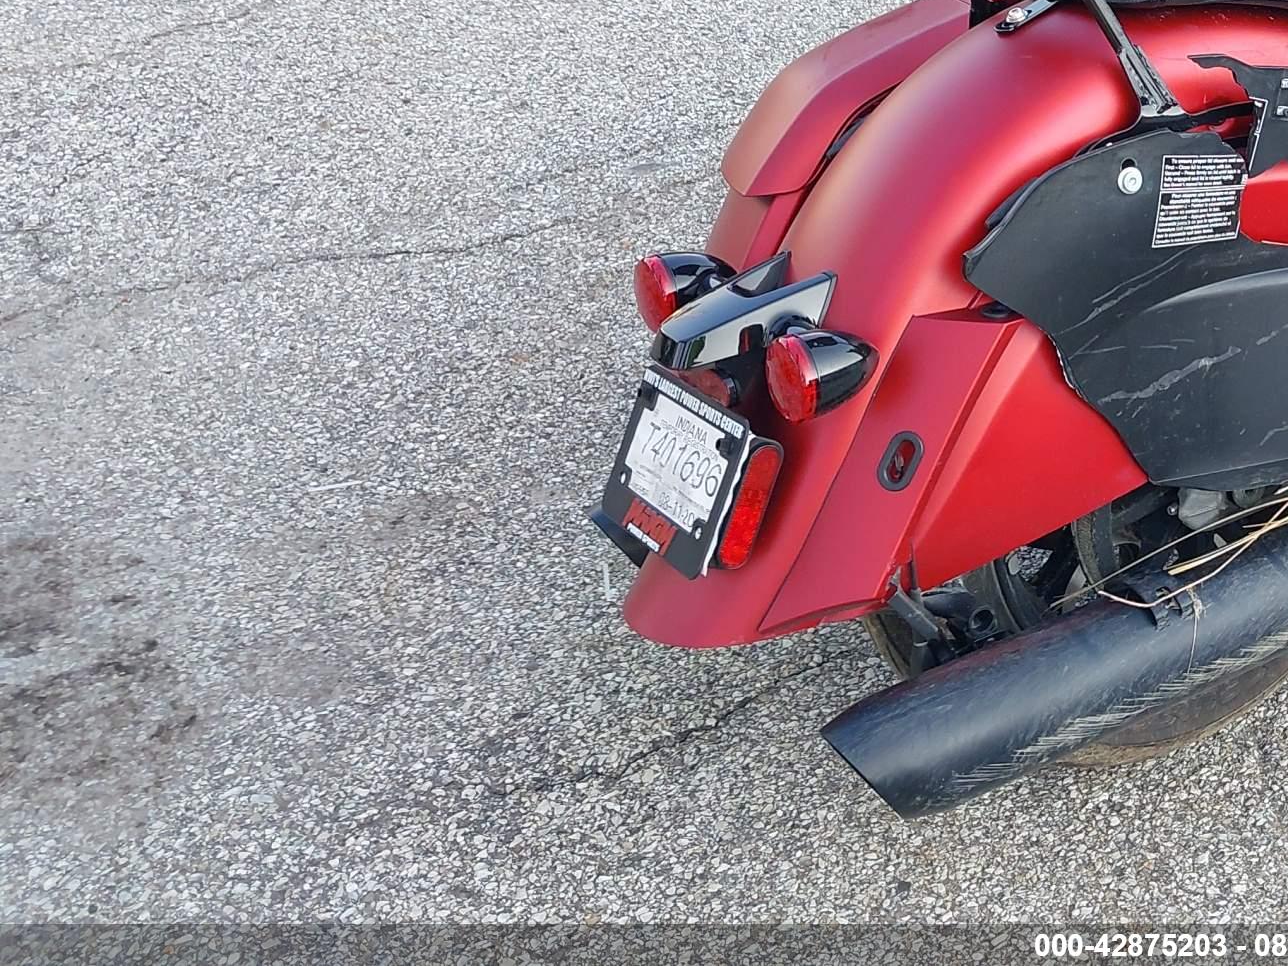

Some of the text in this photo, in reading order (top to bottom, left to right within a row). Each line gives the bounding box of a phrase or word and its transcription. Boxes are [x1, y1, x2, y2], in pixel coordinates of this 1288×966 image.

[658, 376, 682, 401] LARGEST
[679, 389, 701, 415] POWER
[698, 400, 723, 427] SPORTS
[720, 415, 746, 440] CENTER
[675, 415, 708, 445] INDIANA
[641, 421, 723, 498] T401696
